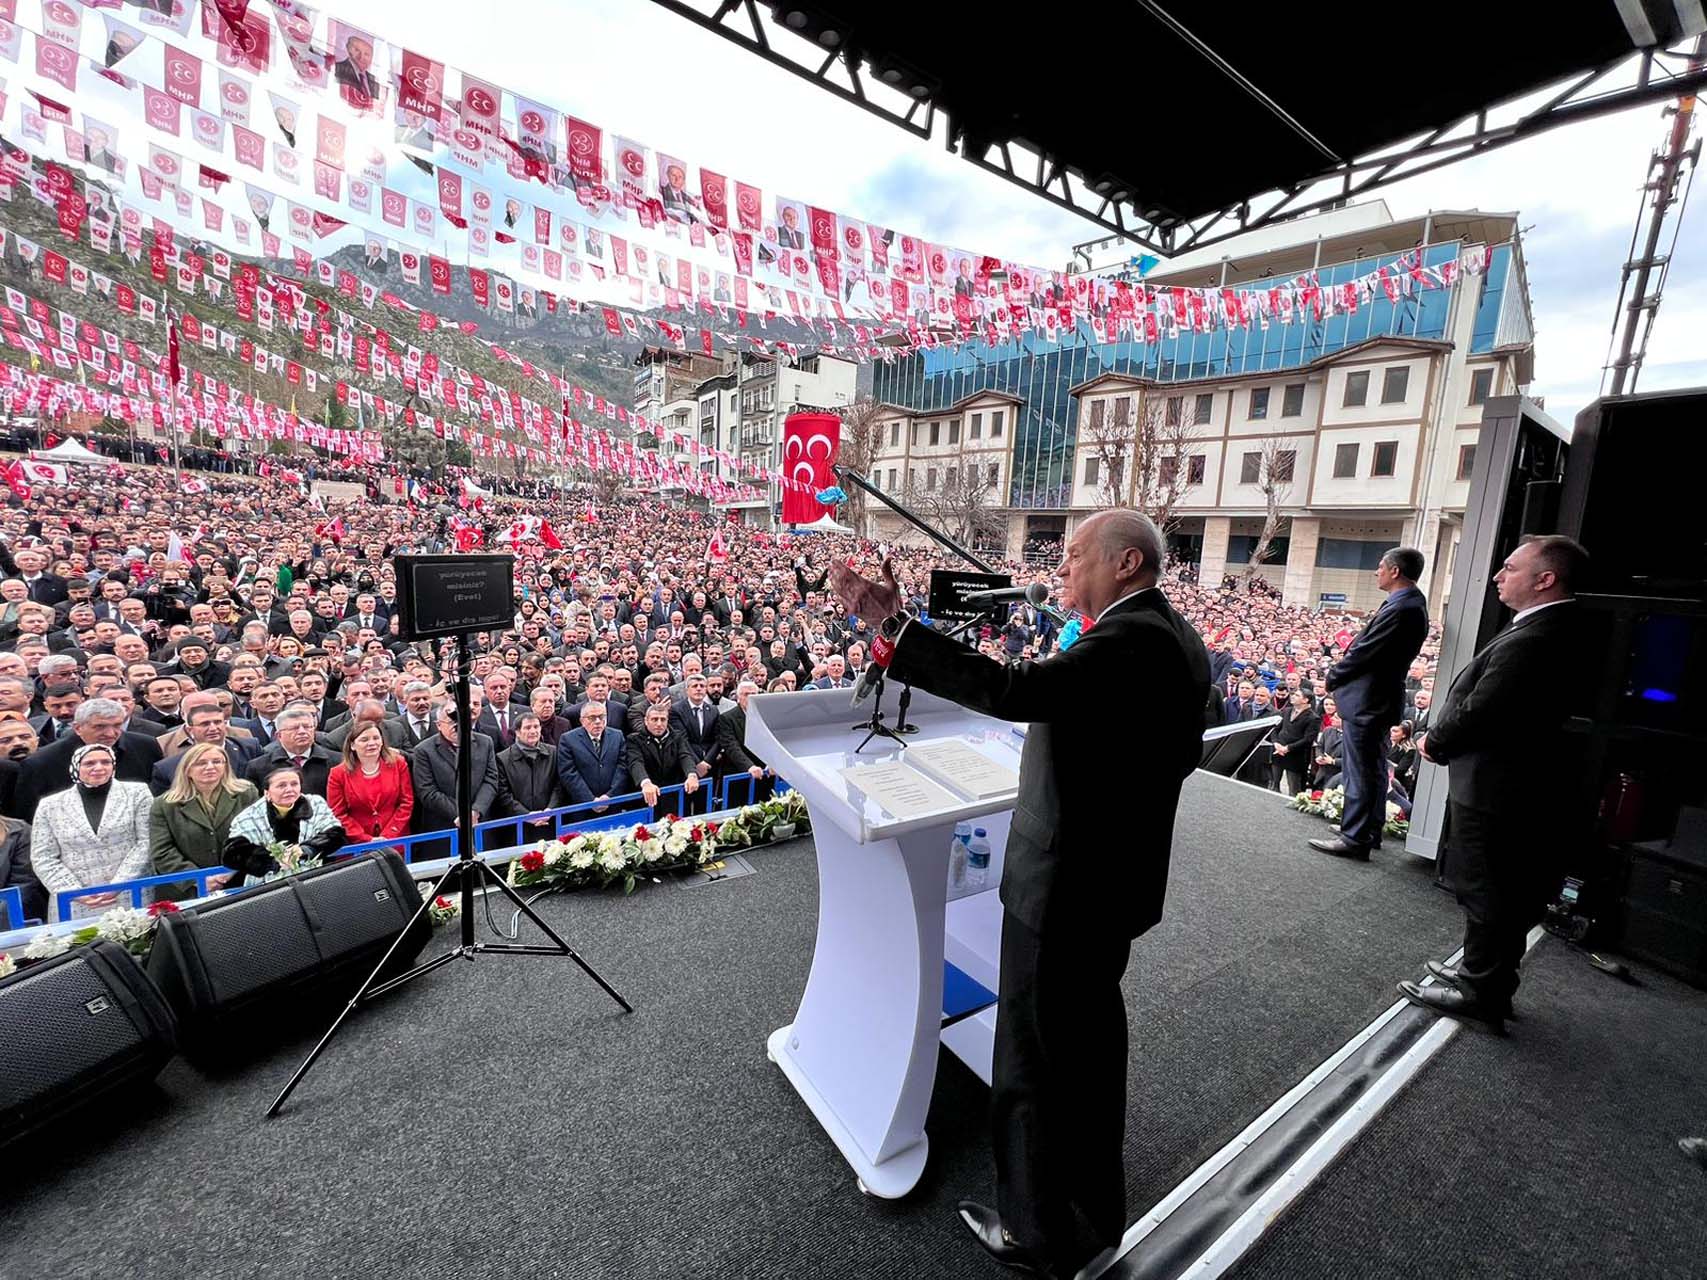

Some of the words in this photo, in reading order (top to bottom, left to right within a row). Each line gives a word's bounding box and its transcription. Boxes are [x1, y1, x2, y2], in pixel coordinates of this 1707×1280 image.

[169, 84, 194, 101] MHP
[405, 96, 436, 114] MHP
[223, 107, 246, 121] MHP
[465, 120, 492, 135] MHP
[363, 167, 383, 180] MHP
[623, 180, 643, 196] MHP
[816, 246, 835, 258] MHP
